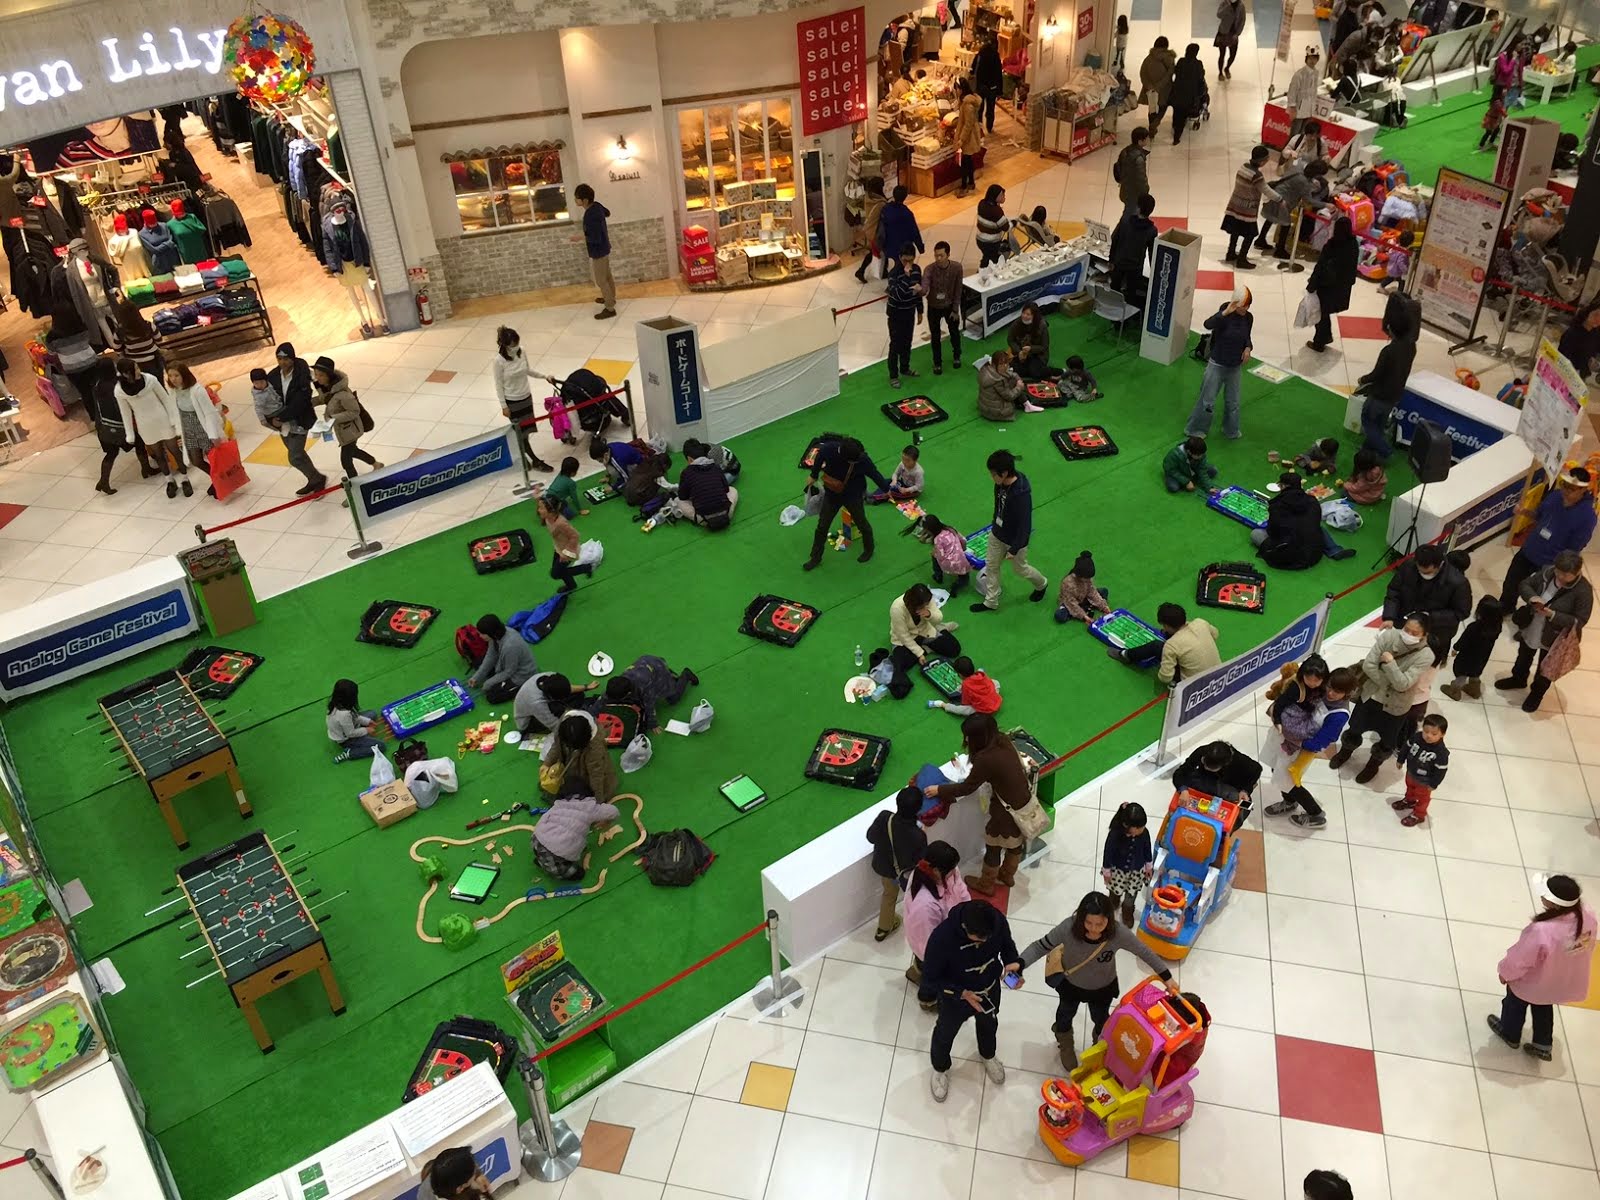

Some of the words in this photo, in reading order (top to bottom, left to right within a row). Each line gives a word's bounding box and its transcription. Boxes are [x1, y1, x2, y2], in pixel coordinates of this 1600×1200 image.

[806, 14, 857, 42] sale!
[807, 34, 858, 62] sale!
[0, 60, 83, 111] an
[102, 27, 228, 82] Lily
[808, 54, 859, 82] sale!
[809, 74, 859, 102] sale!
[811, 93, 860, 120] sale!
[693, 237, 709, 247] SALE
[675, 339, 692, 416] ボードゲームコーナー
[371, 482, 418, 505] Analog
[418, 470, 455, 488] Game
[455, 446, 502, 477] Festival
[7, 646, 66, 678] Analog
[66, 628, 113, 655] Game
[115, 602, 177, 638] Festival
[1185, 674, 1226, 712] Analog
[1226, 656, 1260, 686] Game
[1259, 627, 1309, 666] Festival
